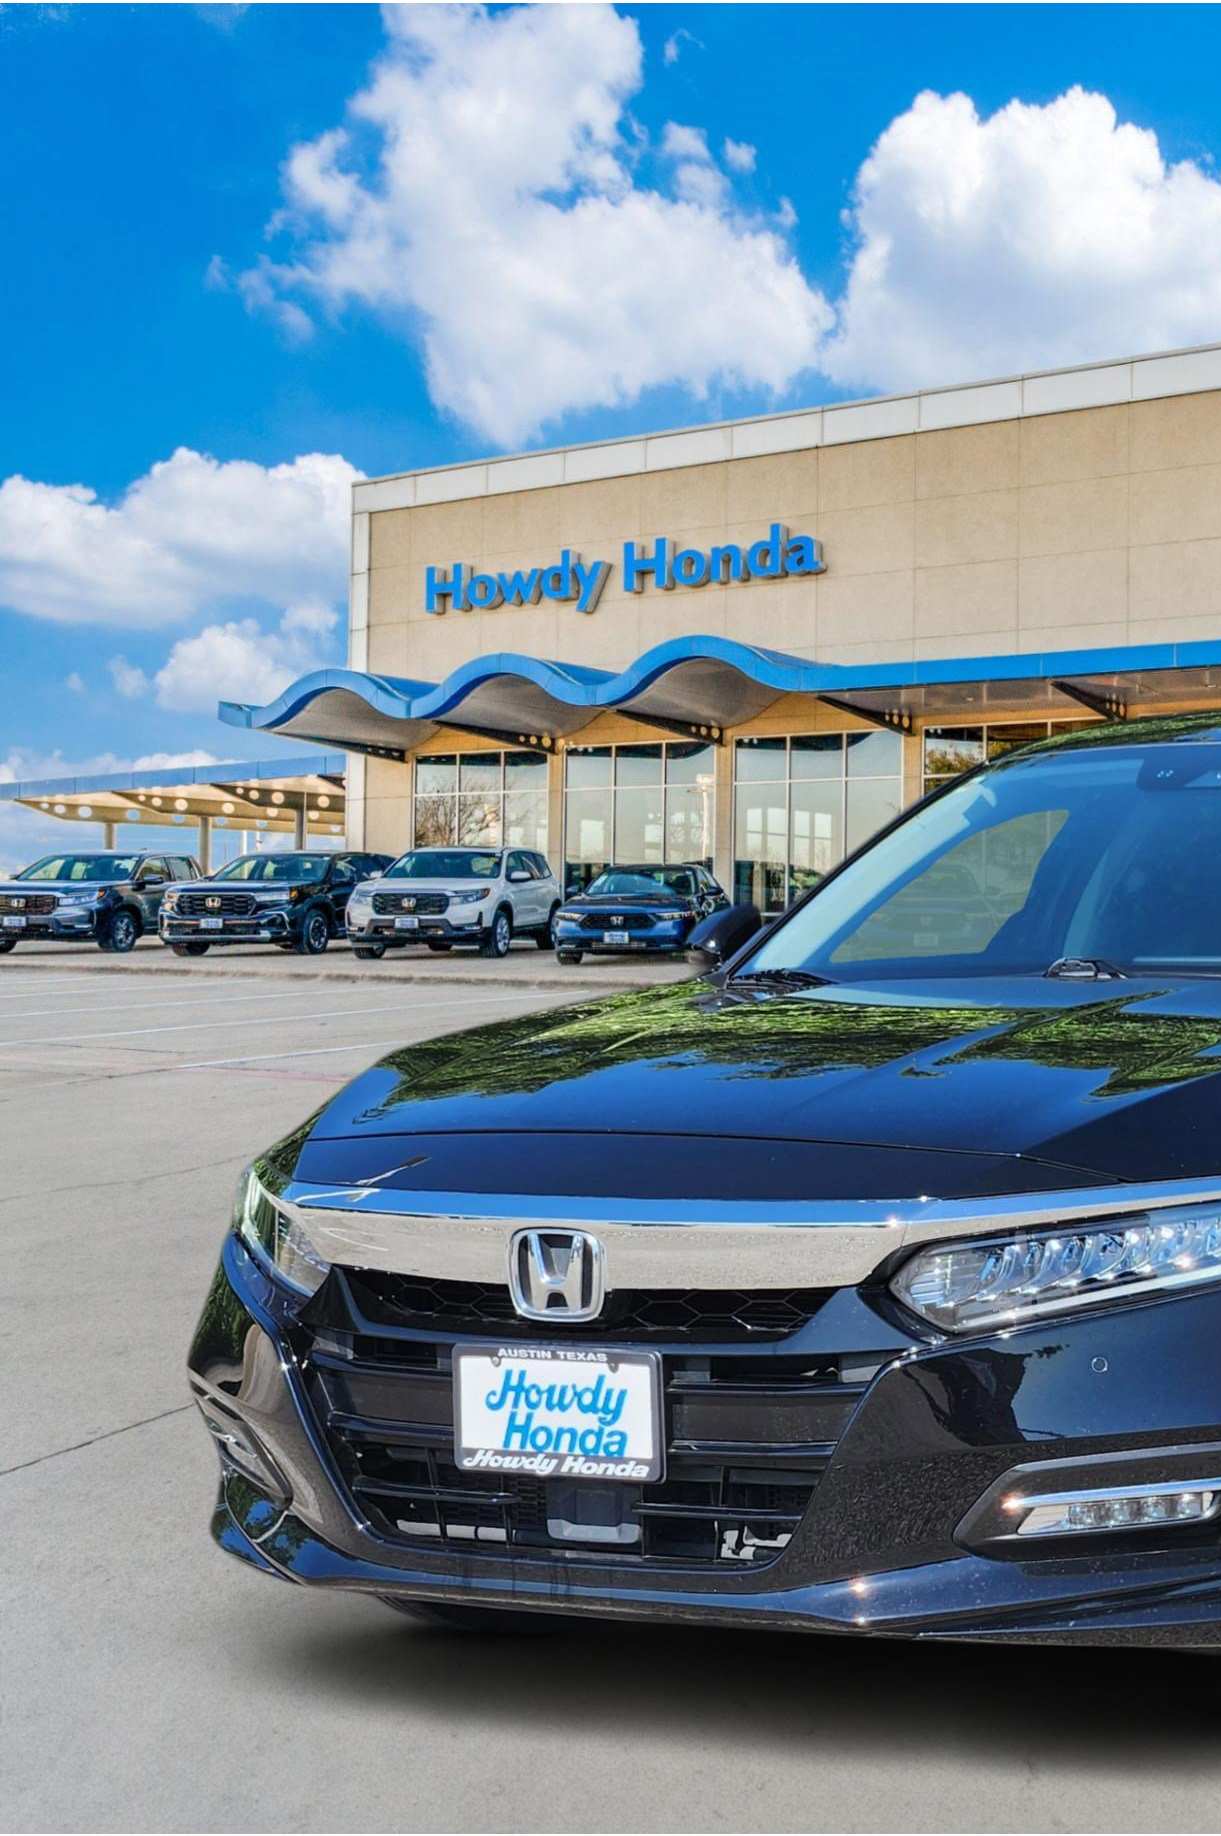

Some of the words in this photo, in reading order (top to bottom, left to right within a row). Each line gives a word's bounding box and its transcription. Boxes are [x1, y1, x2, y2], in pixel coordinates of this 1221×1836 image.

[425, 548, 612, 614] Howdy
[623, 523, 826, 593] Honda
[497, 1347, 552, 1359] AUSTIN
[556, 1350, 608, 1362] TEXAS
[485, 1369, 628, 1426] Howdy
[502, 1411, 628, 1458] Honda
[463, 1449, 555, 1475] Howdy
[560, 1455, 650, 1478] Honda
